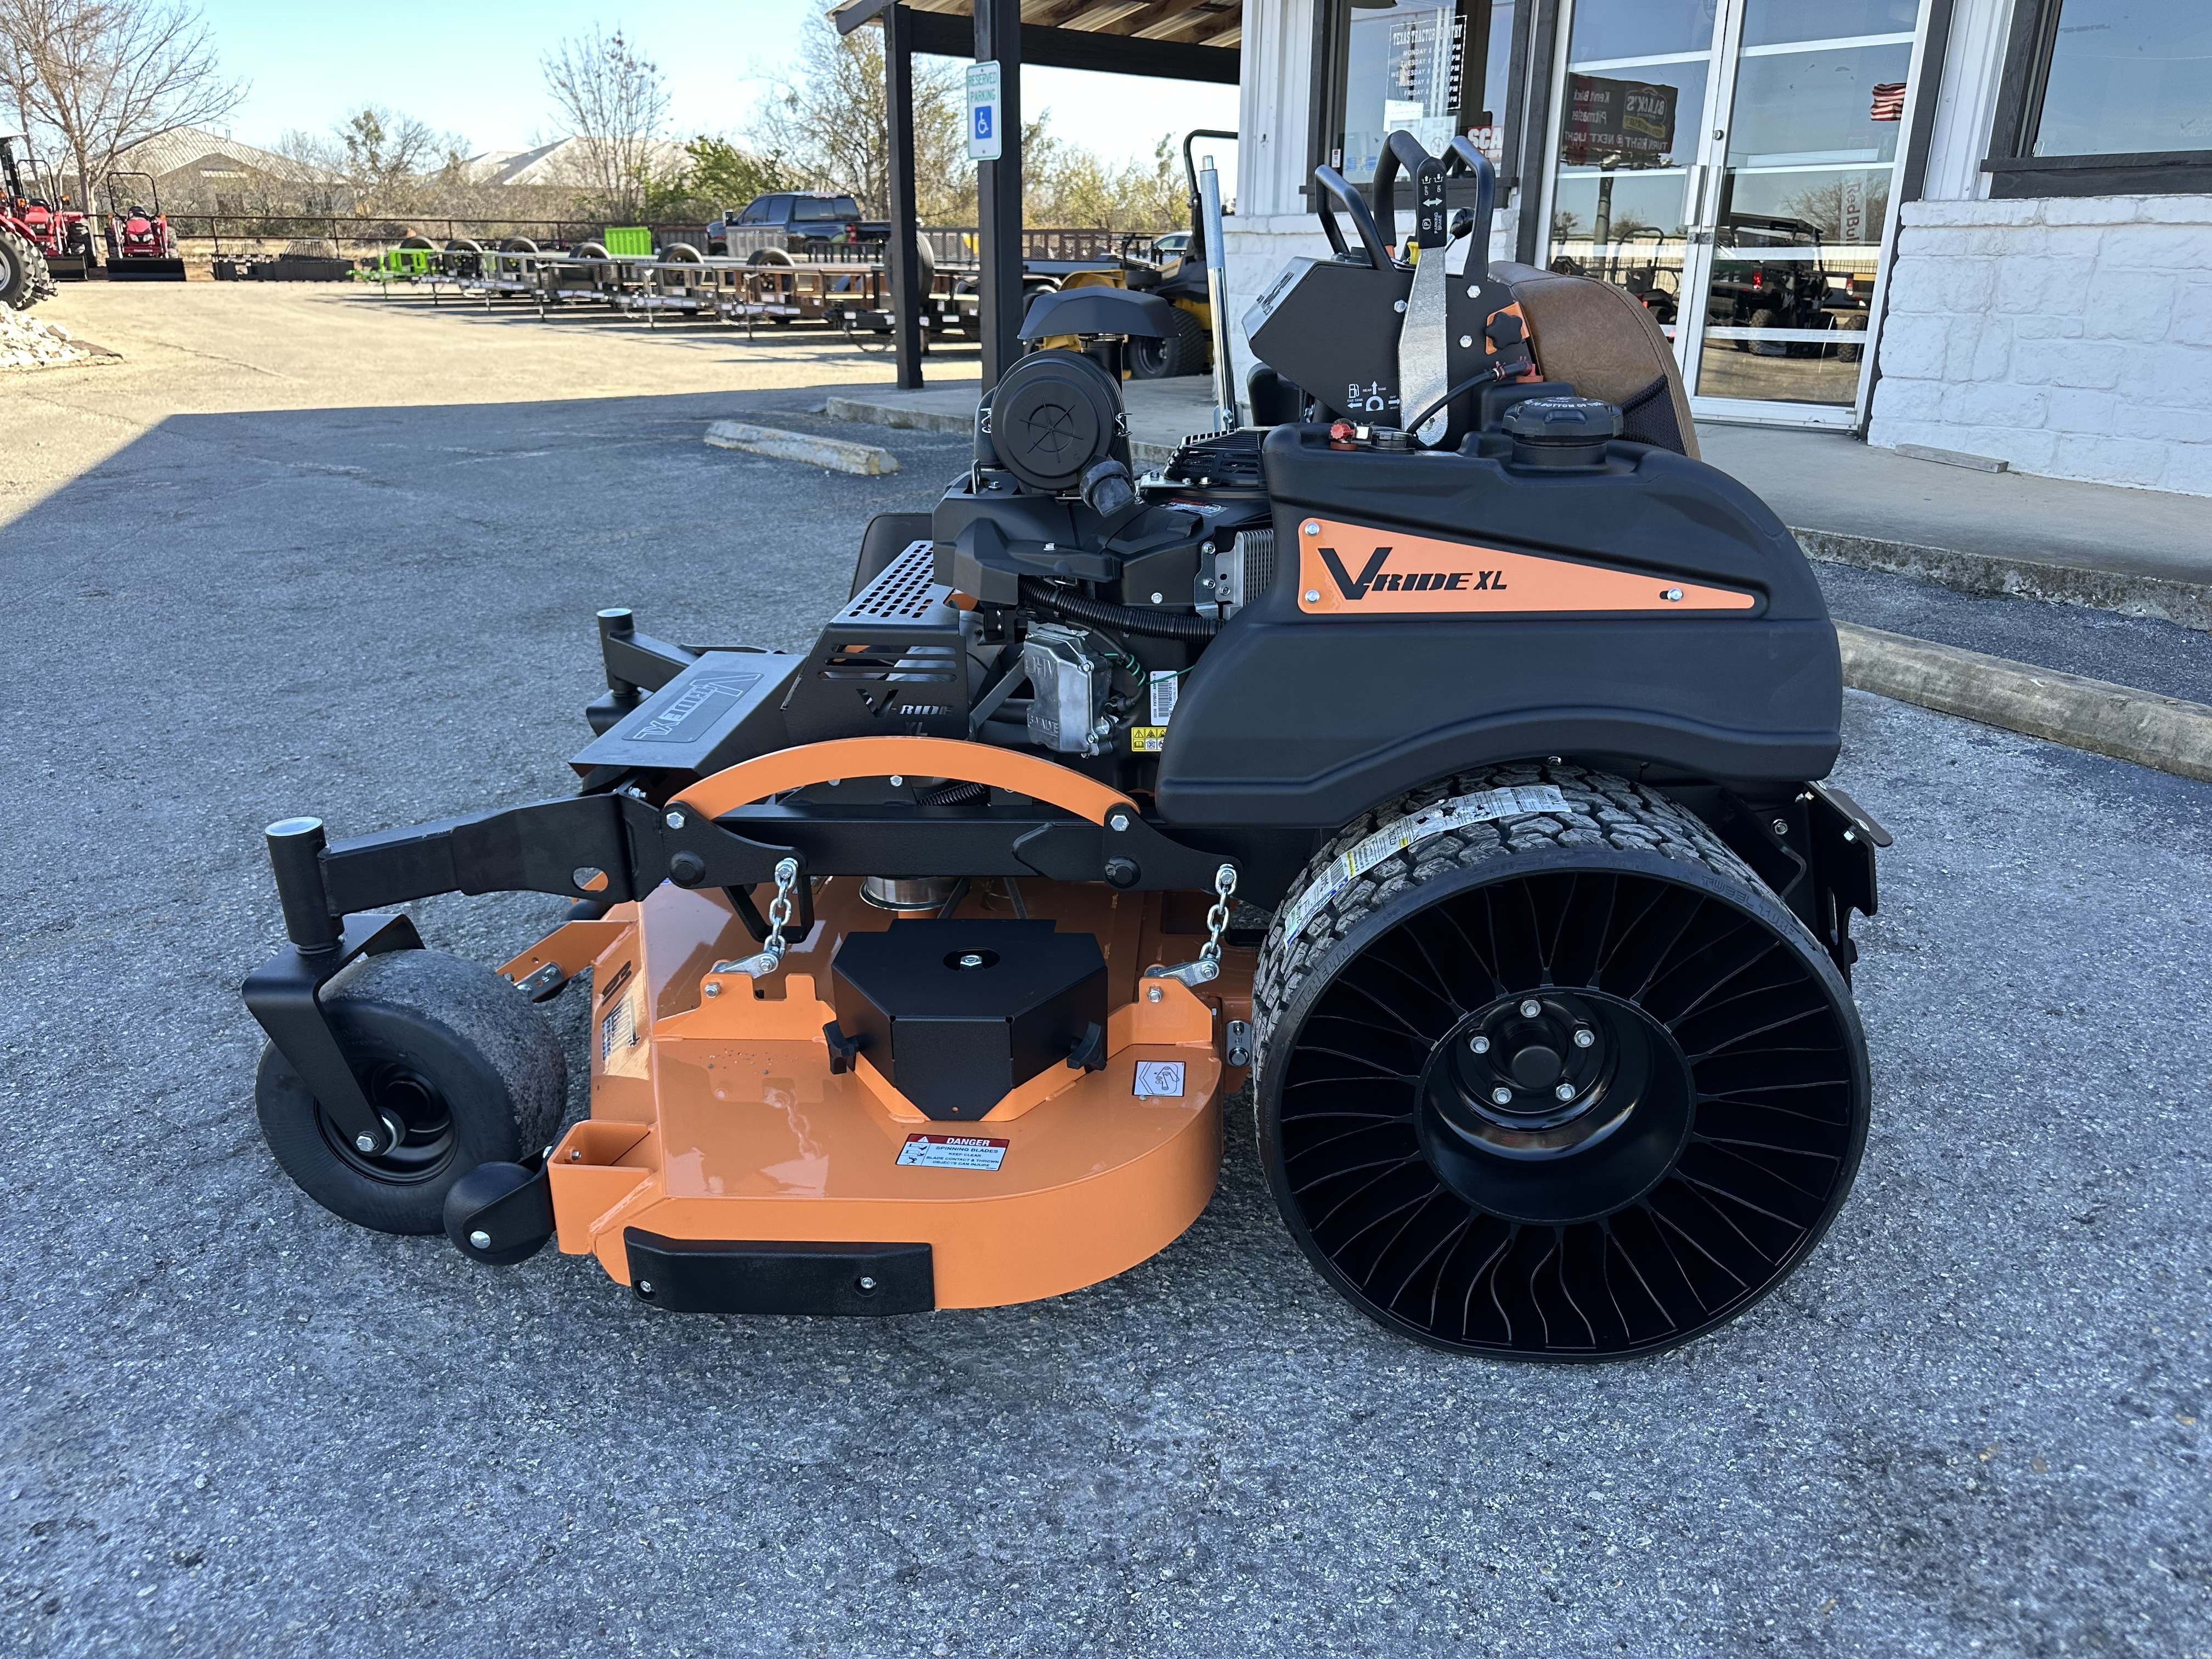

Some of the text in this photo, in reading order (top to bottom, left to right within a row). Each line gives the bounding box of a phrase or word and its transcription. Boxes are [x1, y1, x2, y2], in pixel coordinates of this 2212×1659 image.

[1393, 31, 1410, 46] TEXAS
[1411, 27, 1436, 43] TRACTOR
[968, 72, 996, 86] RESERVED
[970, 89, 996, 103] PARKING
[1468, 127, 1503, 150] SCA
[1847, 183, 1861, 215] Red
[1474, 570, 1508, 591] XL
[1025, 656, 1056, 680] OHV
[633, 720, 681, 740] XL
[904, 721, 928, 736] XL
[1702, 874, 1795, 936] TWEEL TURF
[1291, 943, 1352, 1024] MICHELIN
[946, 1137, 990, 1147] DANGER
